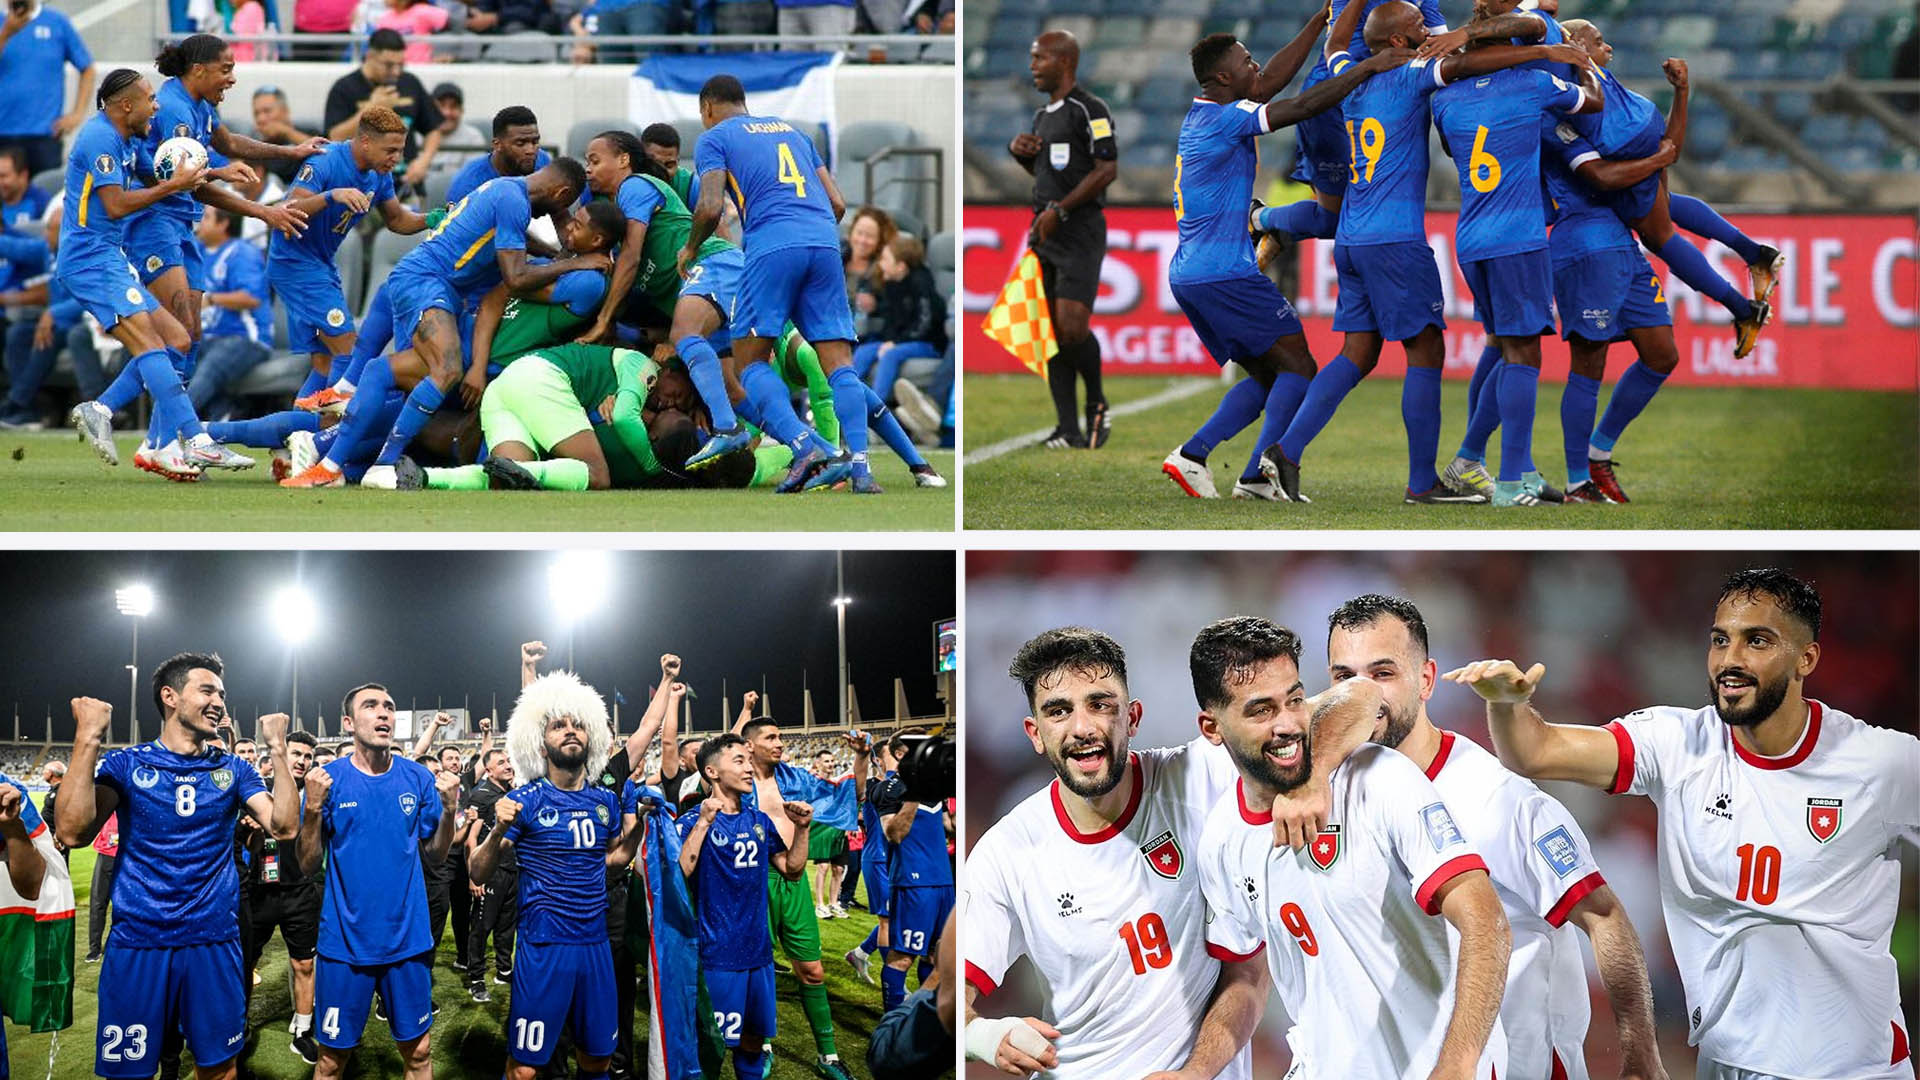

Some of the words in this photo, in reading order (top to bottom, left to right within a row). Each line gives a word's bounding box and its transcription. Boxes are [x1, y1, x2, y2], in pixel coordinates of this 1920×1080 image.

[1345, 117, 1386, 184] 19
[1469, 124, 1502, 193] 6
[778, 142, 806, 198] 4
[1094, 325, 1207, 364] AGER
[175, 775, 197, 783] JAKO
[214, 772, 230, 781] UFA
[175, 784, 196, 817] 8
[339, 801, 358, 809] JAKO
[1705, 806, 1733, 821] KELME
[568, 818, 596, 849] 10
[1145, 834, 1169, 852] JORDAN
[734, 840, 760, 869] 22
[1735, 842, 1782, 906] 10
[902, 929, 925, 951] 13
[1118, 912, 1173, 975] 19
[1279, 902, 1319, 957] 9
[322, 1006, 340, 1040] 4
[515, 1017, 545, 1052] 10
[102, 1024, 148, 1062] 23
